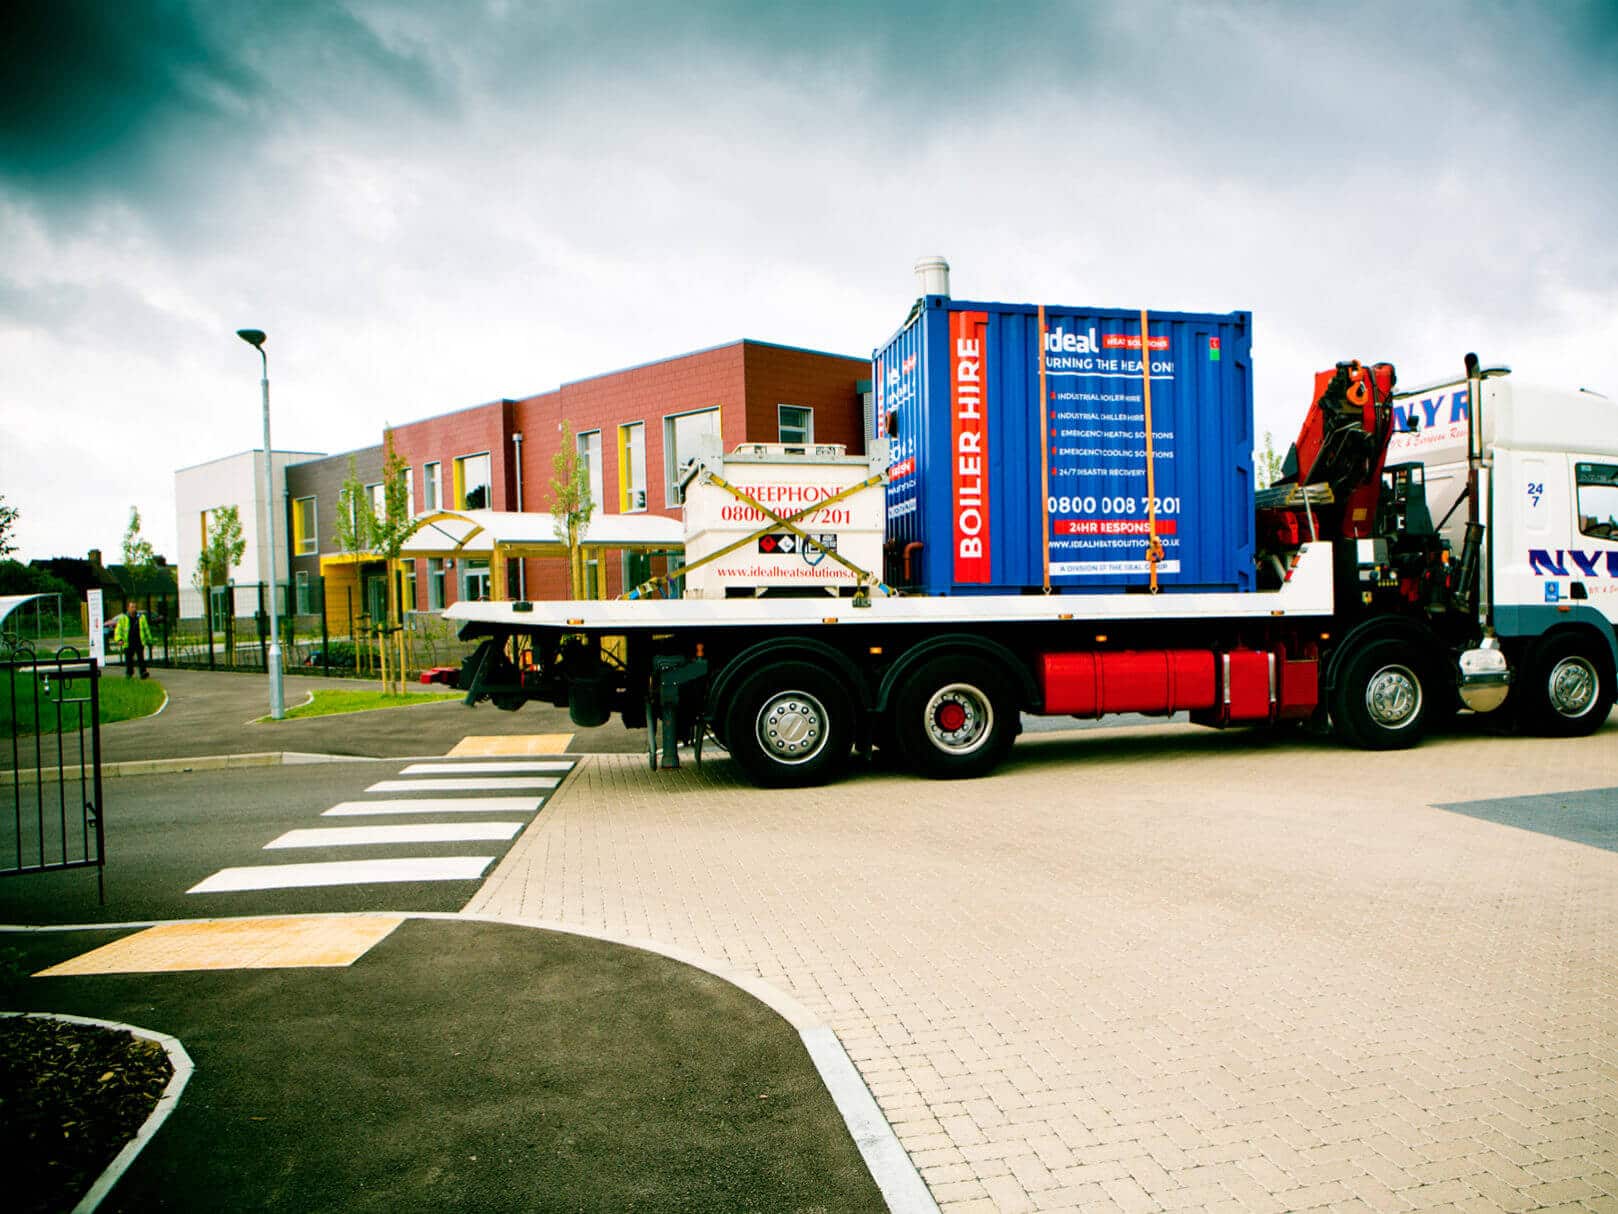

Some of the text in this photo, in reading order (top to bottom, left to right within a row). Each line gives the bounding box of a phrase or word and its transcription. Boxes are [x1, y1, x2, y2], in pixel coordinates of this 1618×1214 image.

[1044, 324, 1100, 353] ideal
[1127, 339, 1168, 348] SOLIONS
[1038, 356, 1093, 369] URNING
[1096, 358, 1118, 370] THE
[1121, 360, 1149, 372] HEA
[1061, 429, 1102, 438] EMEGENC
[957, 338, 982, 558] BOILER HIRE
[1059, 448, 1101, 456] EMEGENC
[1134, 450, 1174, 459] SOTIONS
[1527, 483, 1544, 495] 24
[1047, 496, 1181, 514] 0800 008 7201
[1531, 496, 1540, 507] 7
[721, 505, 766, 521] 0800
[811, 508, 851, 524] 7201
[1101, 523, 1152, 533] ESPONS
